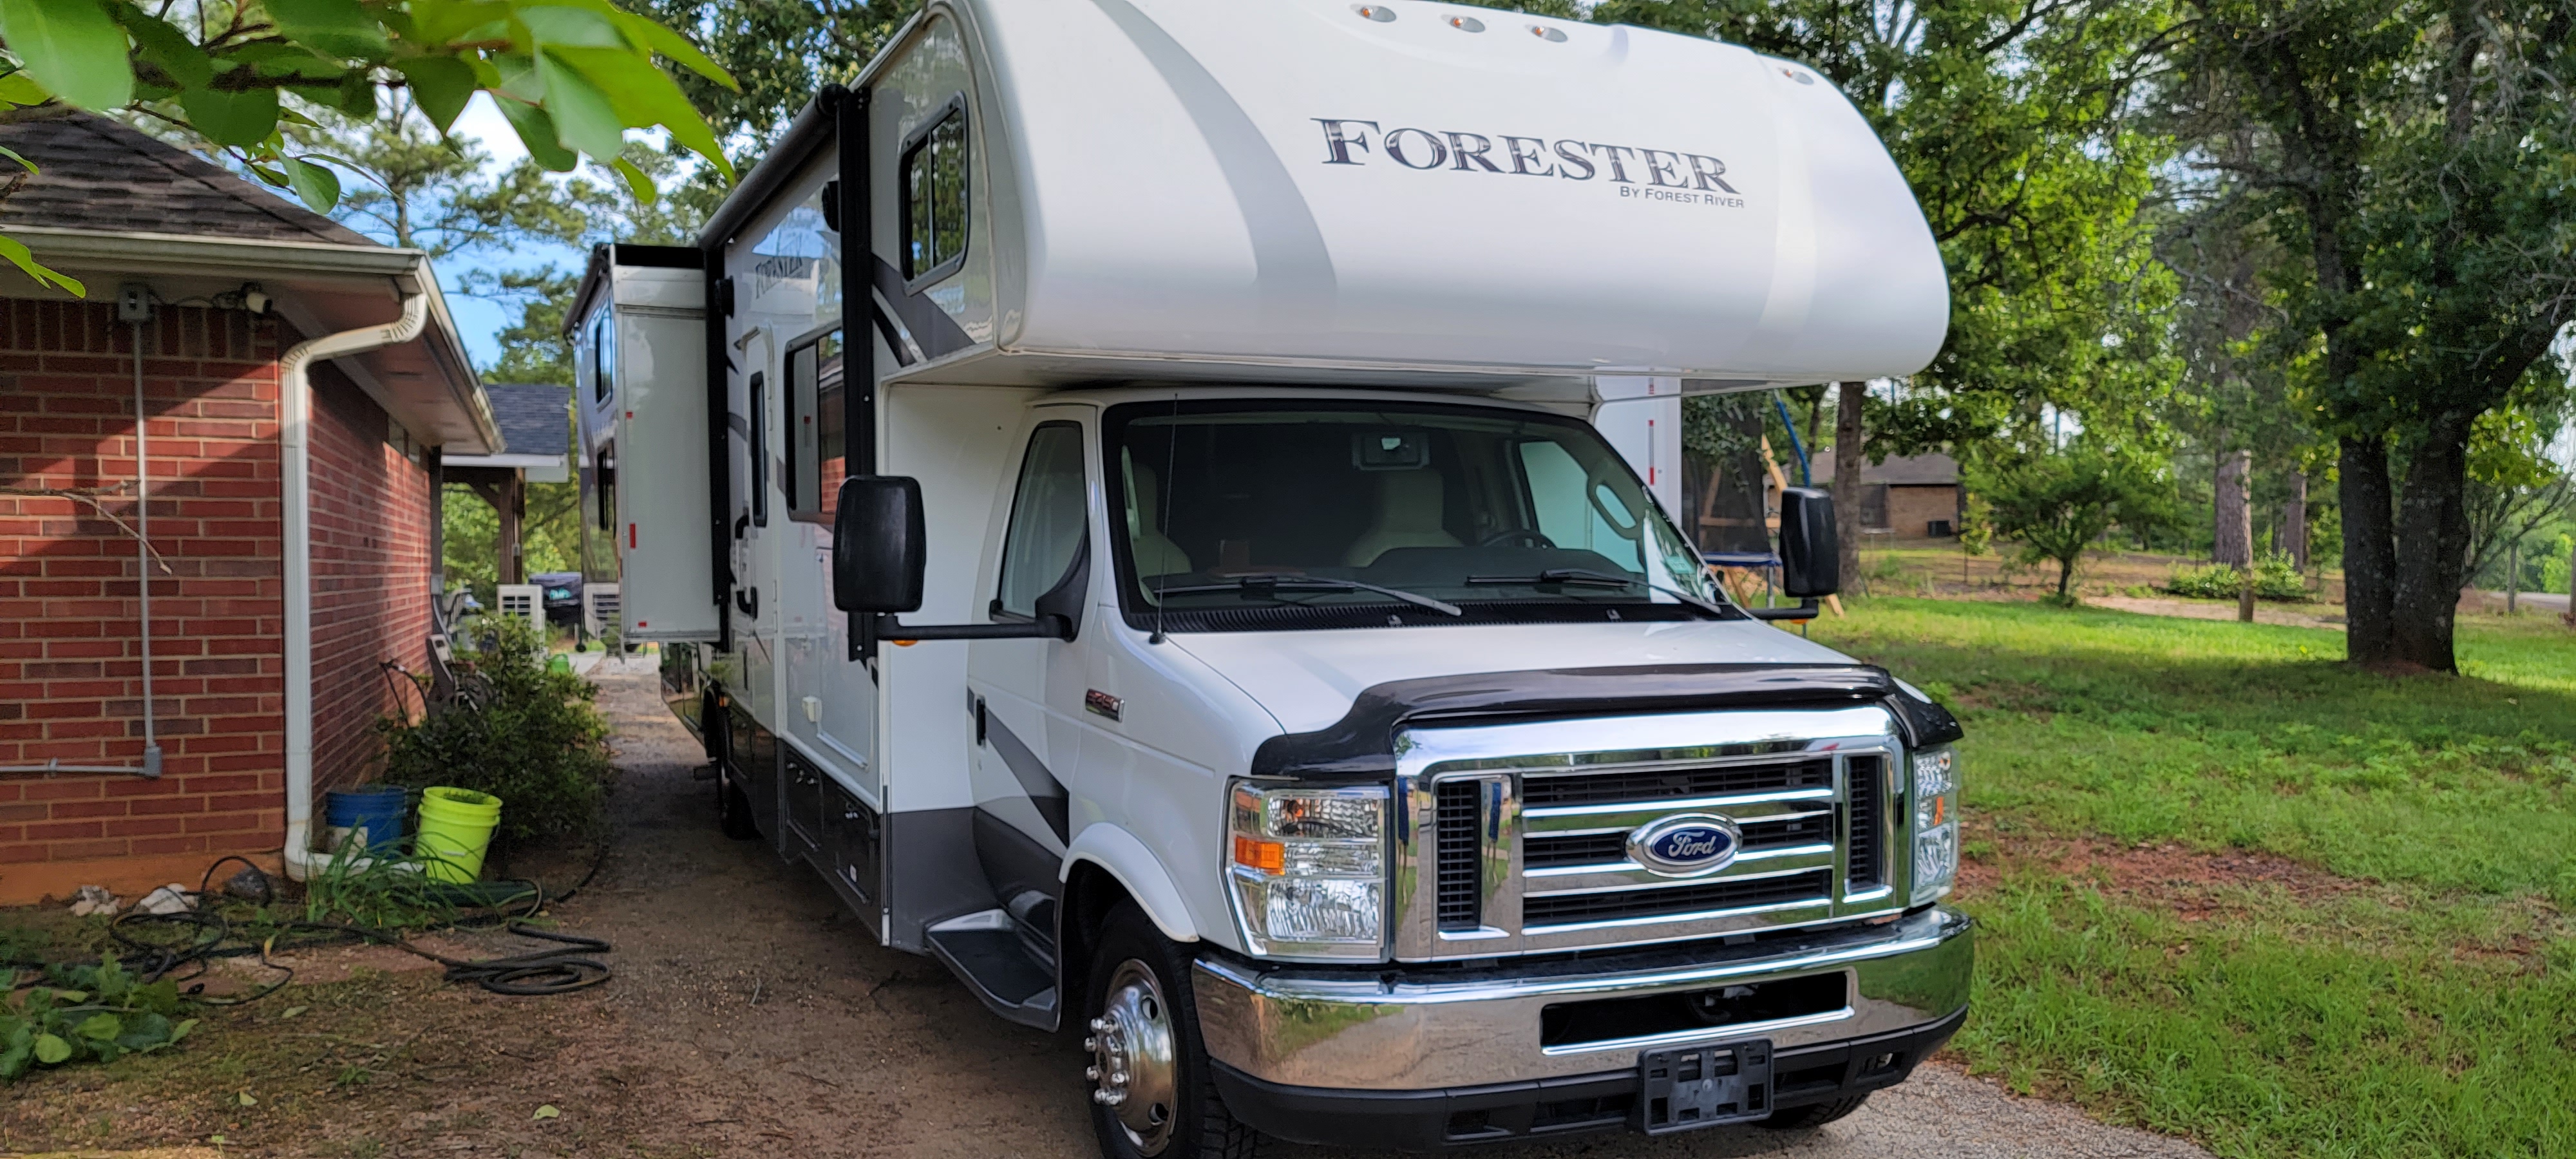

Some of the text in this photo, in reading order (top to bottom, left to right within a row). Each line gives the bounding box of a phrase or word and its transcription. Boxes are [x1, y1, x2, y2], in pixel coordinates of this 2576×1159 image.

[1310, 118, 1741, 194] FORESTER
[1645, 188, 1700, 204] FOREST
[1705, 194, 1745, 209] RIVER
[1668, 831, 1716, 857] Ford
